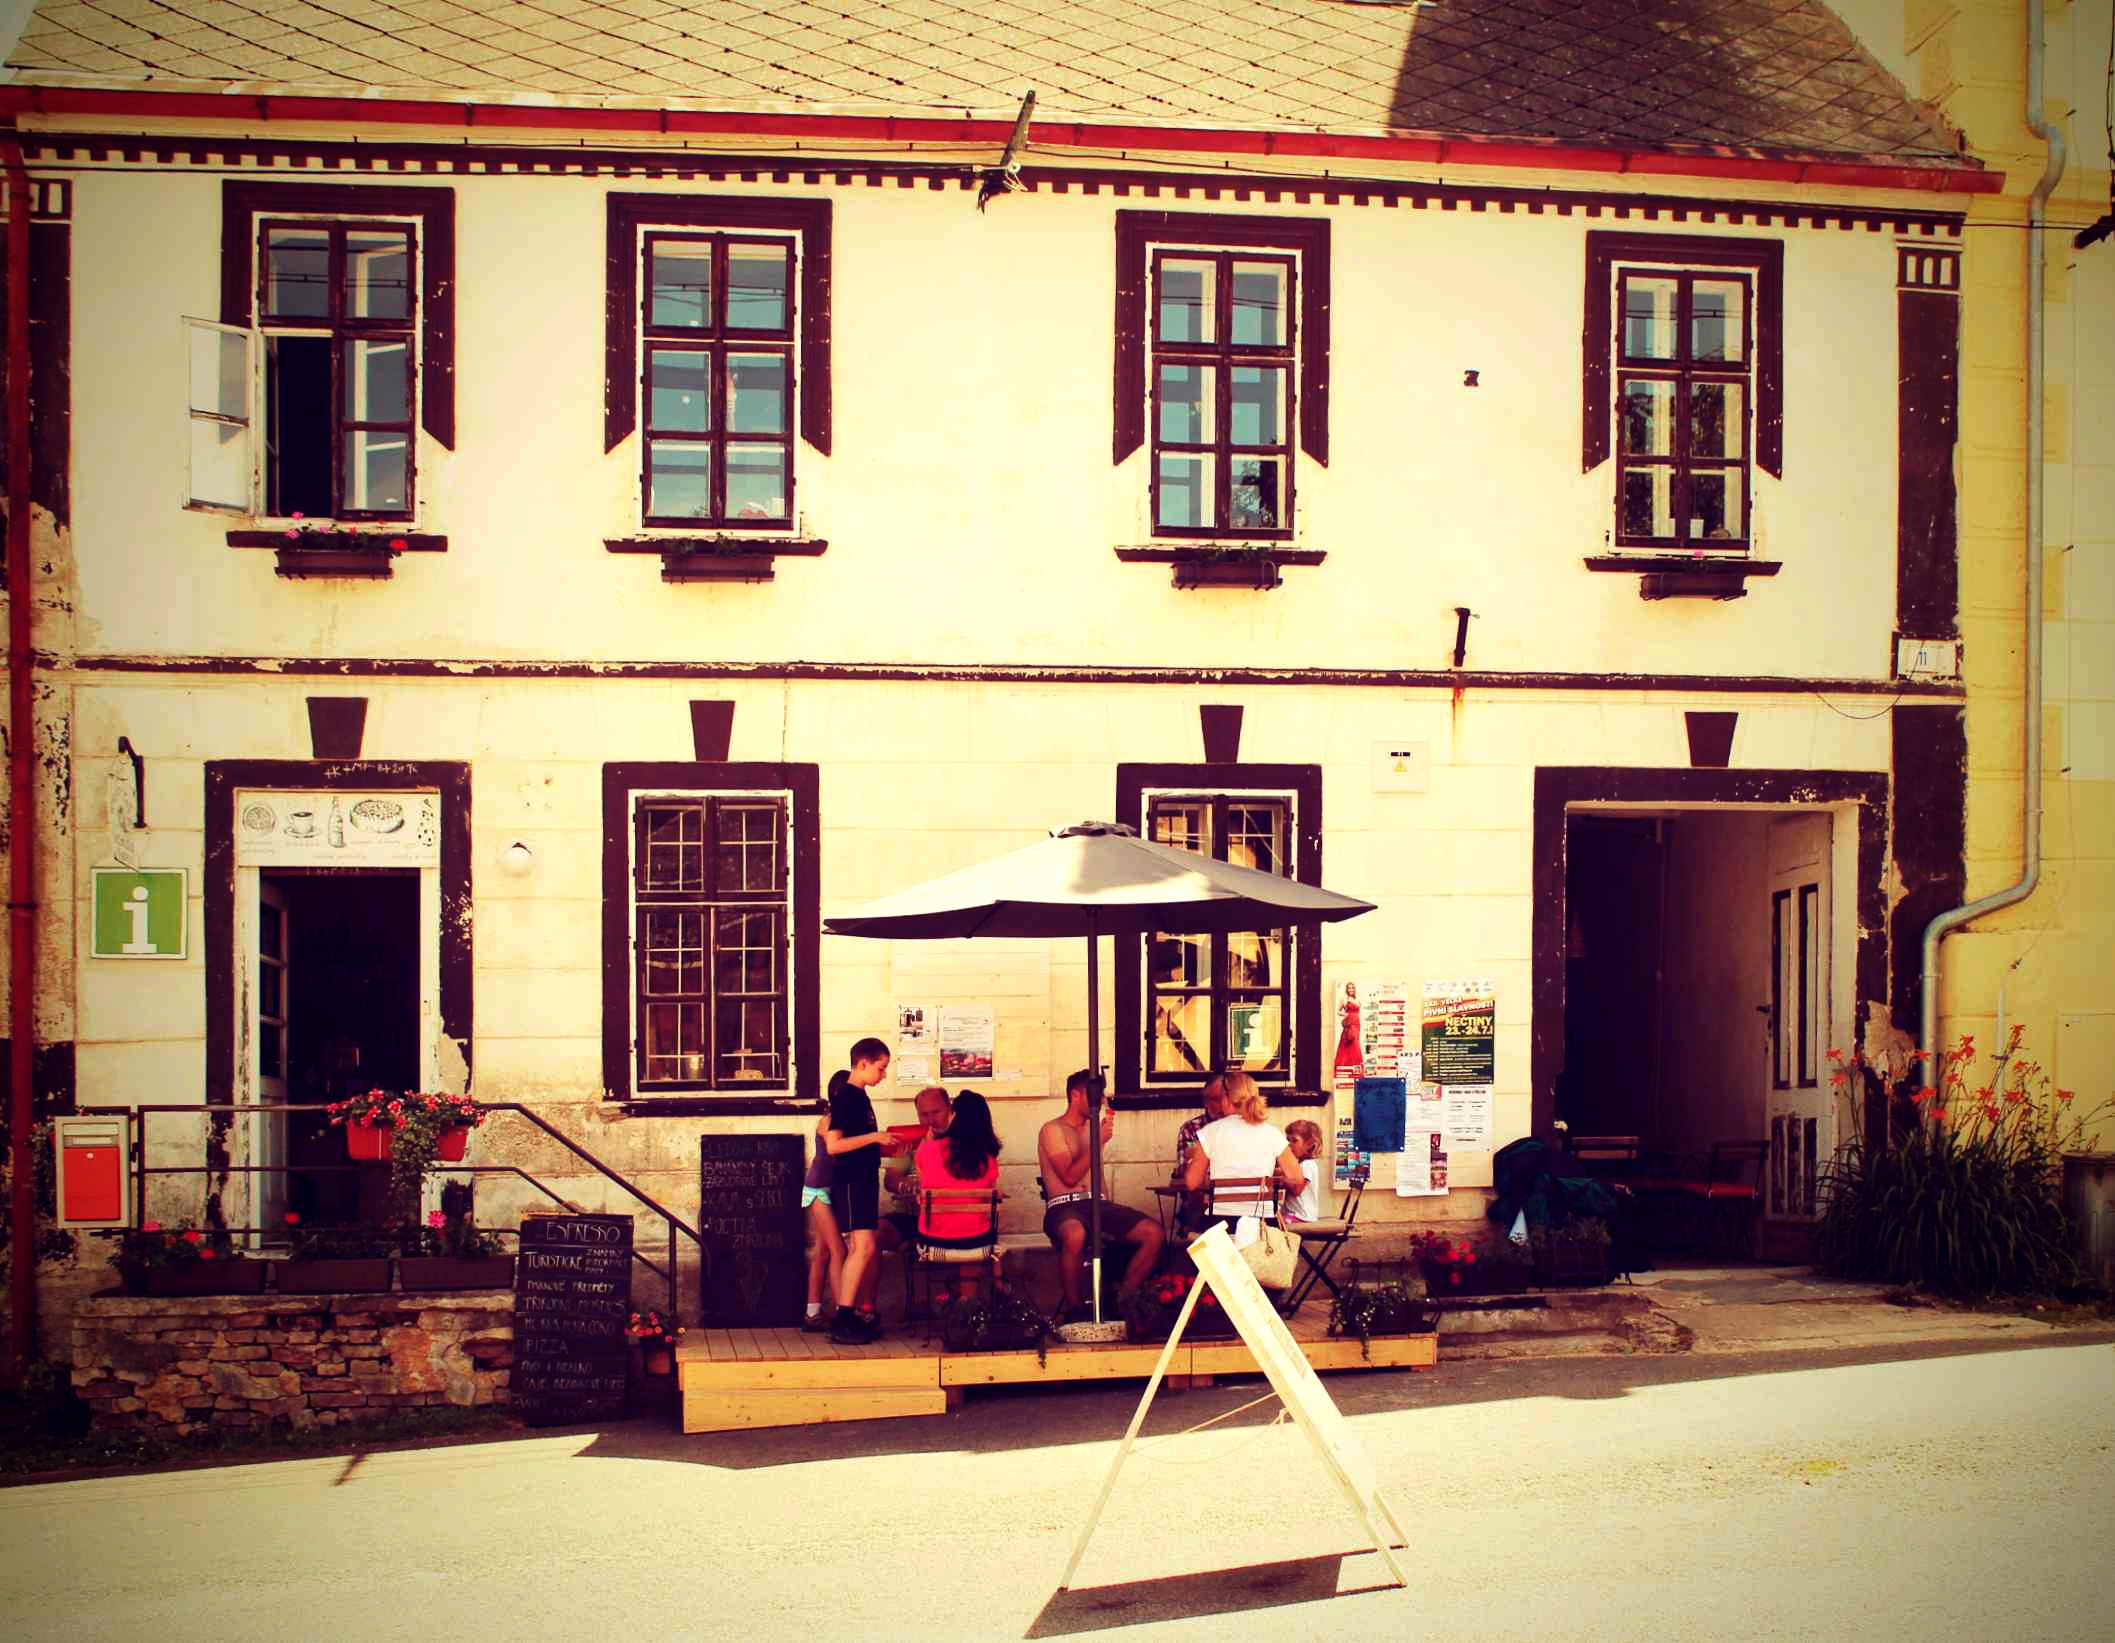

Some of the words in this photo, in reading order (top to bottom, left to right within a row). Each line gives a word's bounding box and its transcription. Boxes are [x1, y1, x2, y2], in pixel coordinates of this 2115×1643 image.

[122, 886, 158, 953] i
[1445, 1014, 1493, 1027] NEČTINY
[546, 1221, 620, 1243] ESPRESSO
